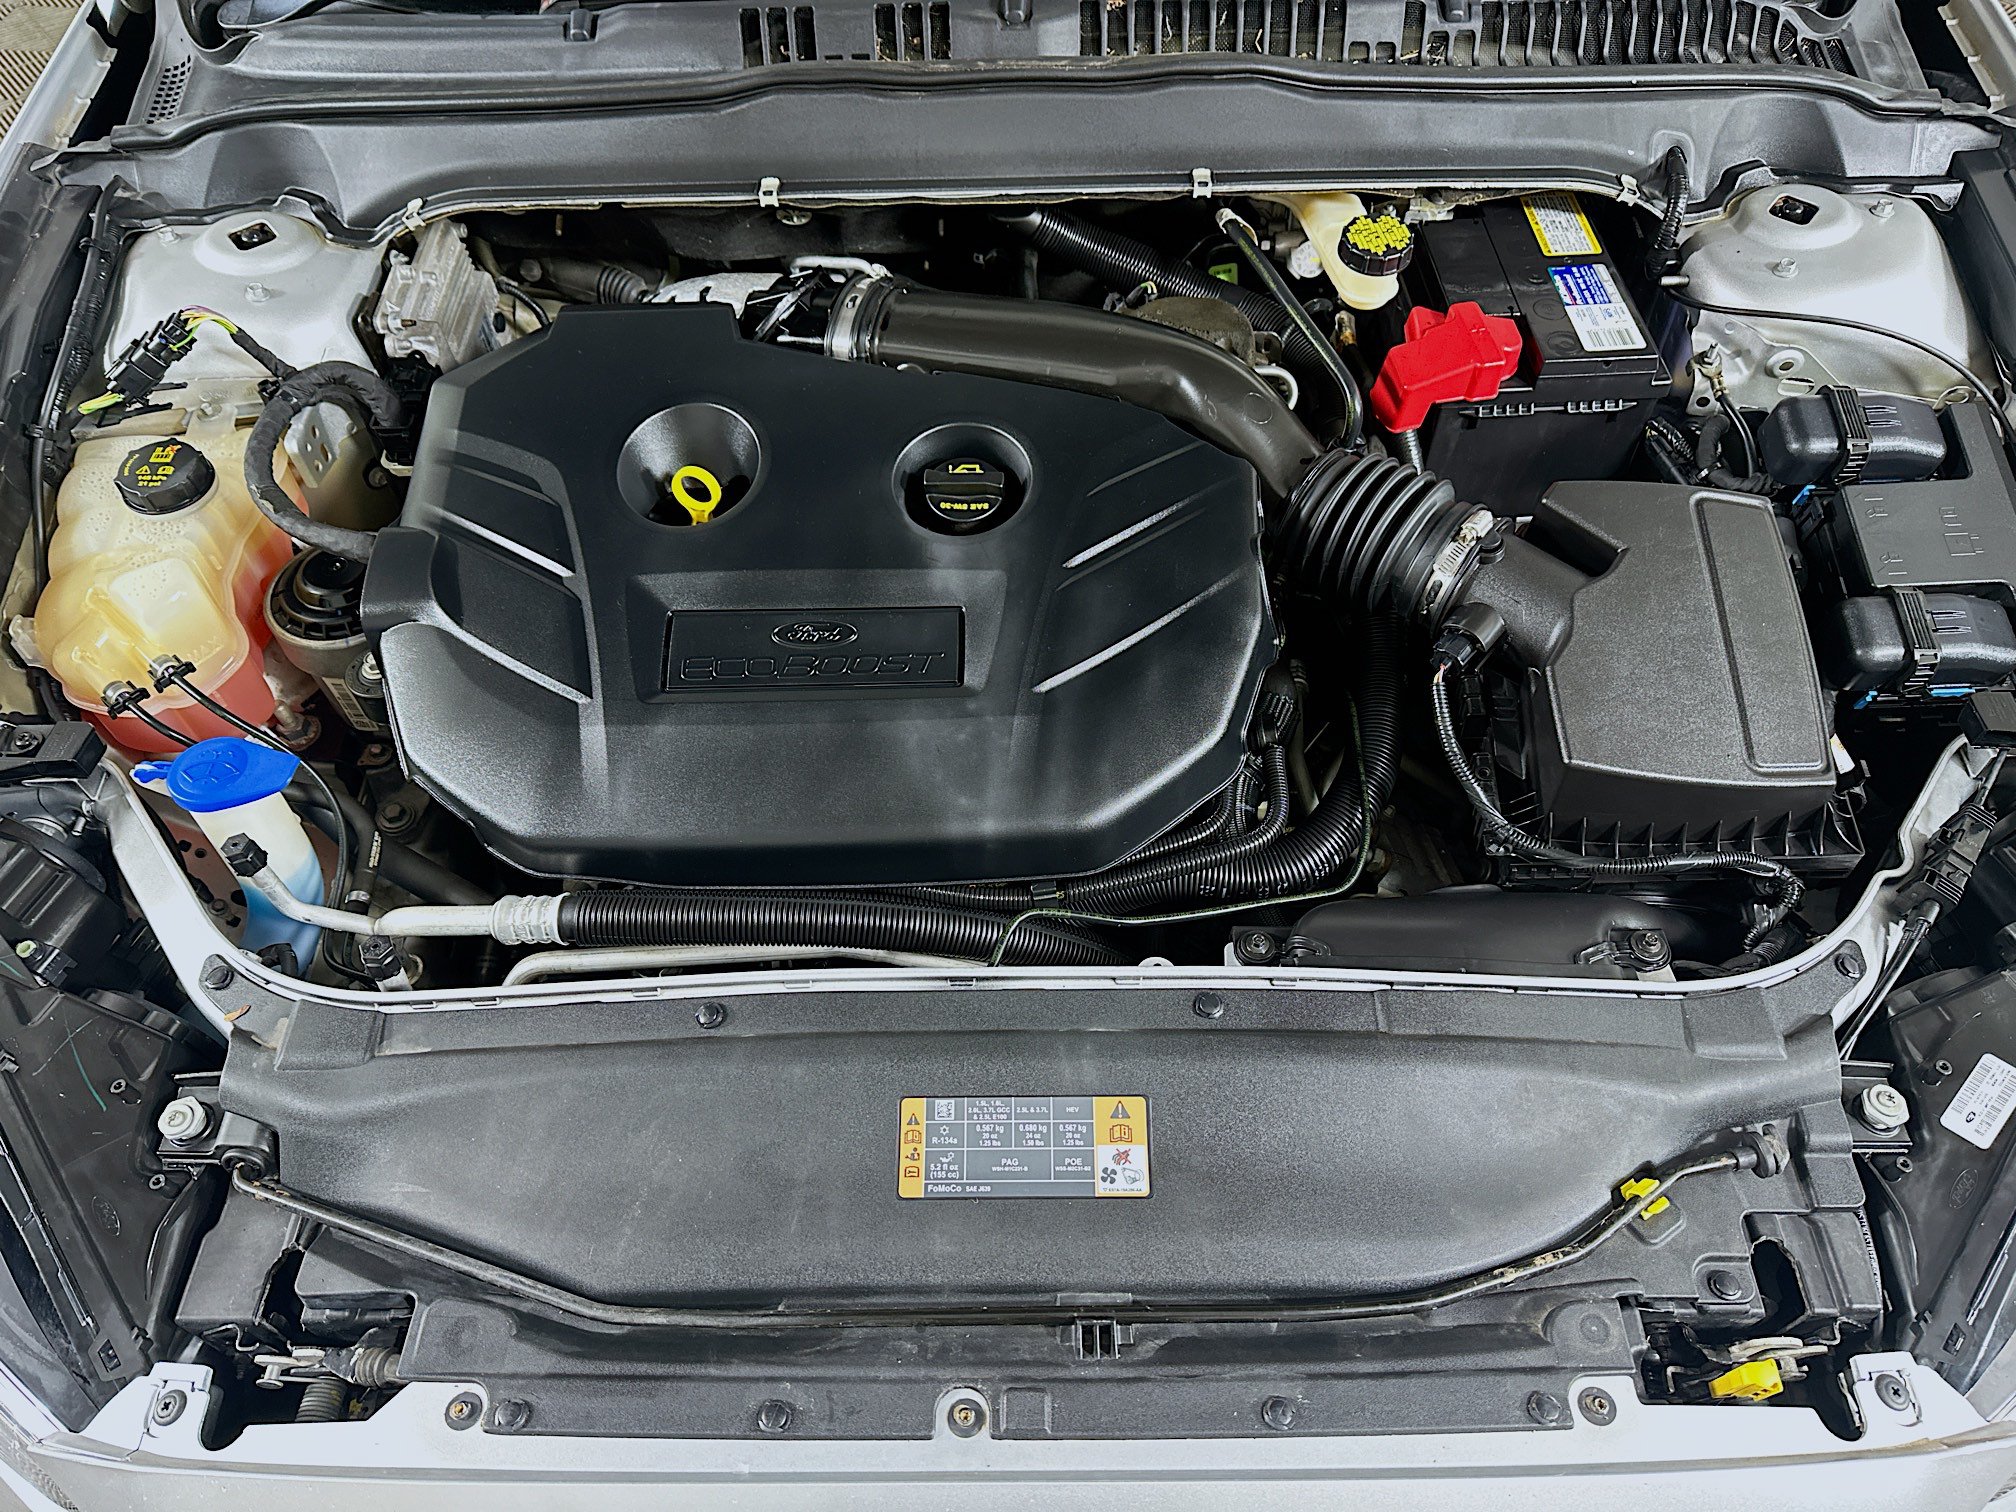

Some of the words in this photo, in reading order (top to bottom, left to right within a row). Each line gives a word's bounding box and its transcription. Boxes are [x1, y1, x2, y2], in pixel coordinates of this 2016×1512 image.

[970, 502, 989, 510] SAE
[787, 622, 842, 643] Ford
[976, 1124, 994, 1132] 0.567
[995, 1124, 1004, 1133] kg
[1038, 1124, 1047, 1133] kg
[1059, 1124, 1077, 1132] 0.567
[1078, 1124, 1087, 1133] kg
[931, 1136, 958, 1144] R-134a
[1001, 1158, 1019, 1166] PAG
[1064, 1157, 1082, 1166] POE
[930, 1171, 946, 1179] (155
[947, 1171, 959, 1179] cc)
[927, 1184, 962, 1193] FoMoCo
